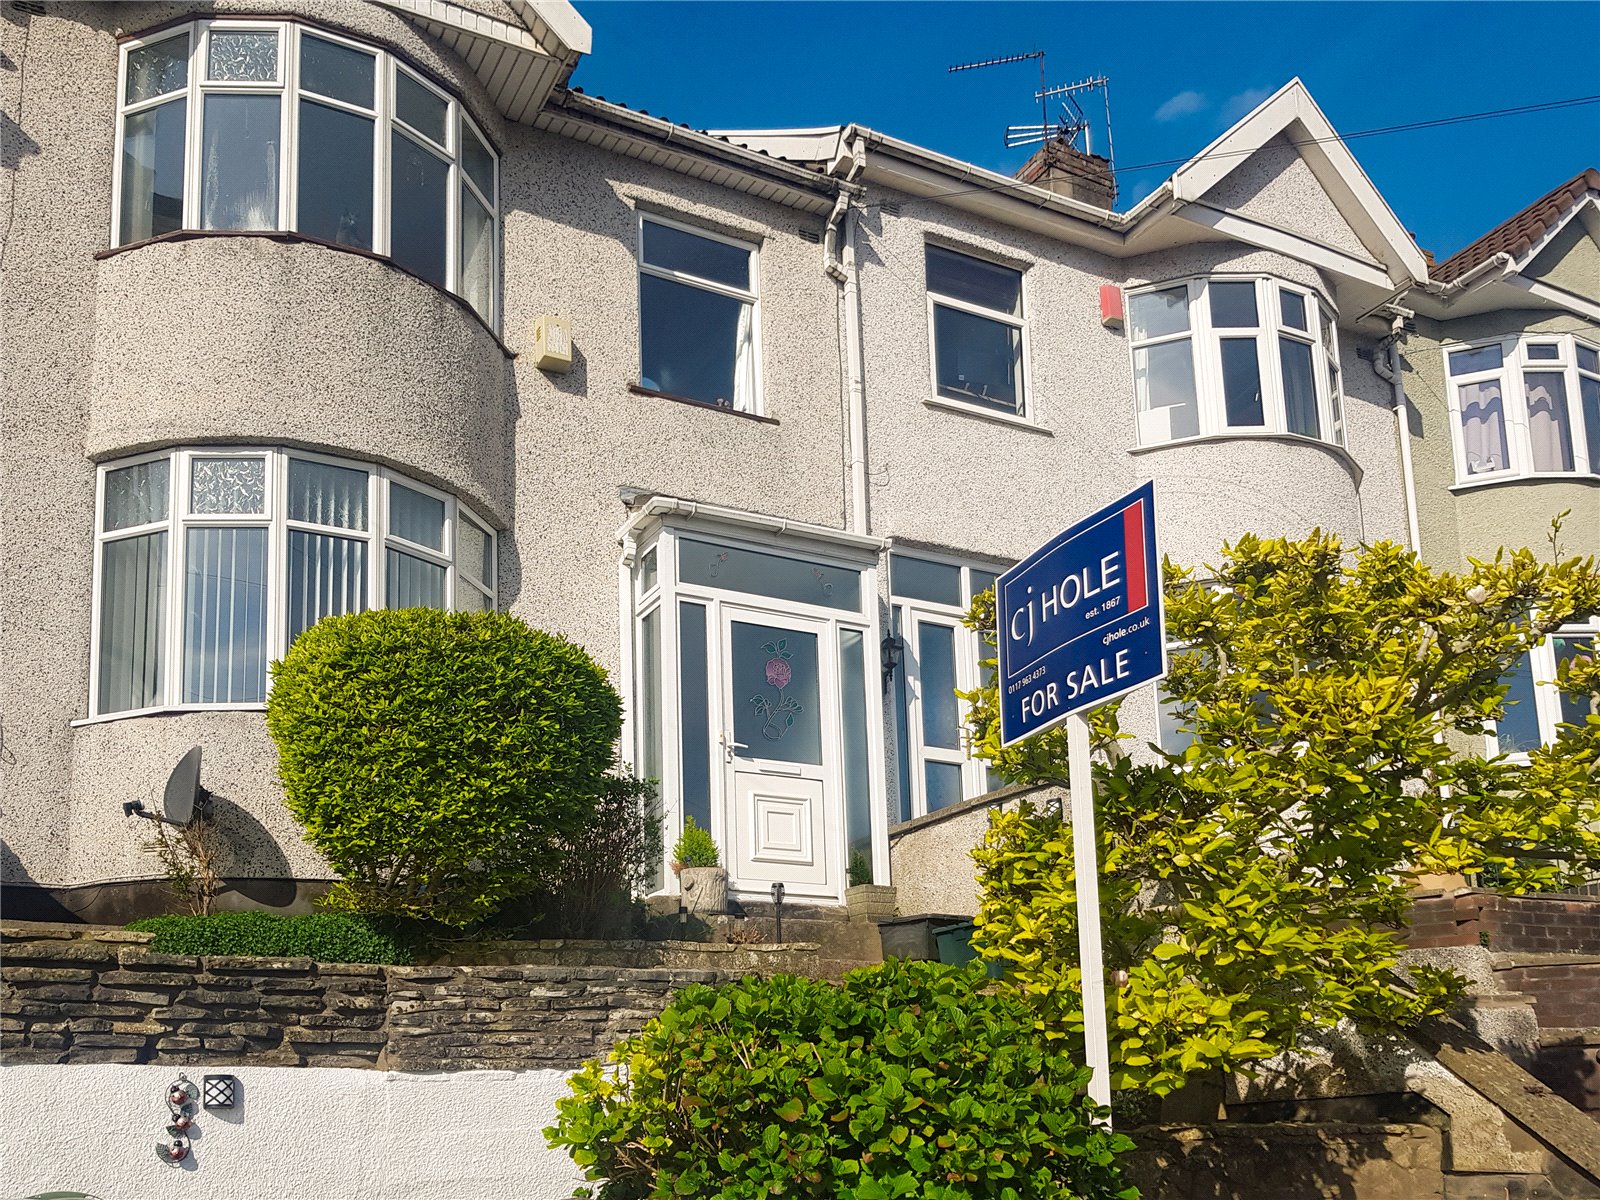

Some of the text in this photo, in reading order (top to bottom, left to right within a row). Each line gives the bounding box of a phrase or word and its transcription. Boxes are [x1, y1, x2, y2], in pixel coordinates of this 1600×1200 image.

[1041, 551, 1121, 623] HOLE
[1085, 595, 1121, 620] est. 1867
[1102, 616, 1150, 646] cjhole.co.uk
[1008, 665, 1046, 695] 0117 963 4373
[1021, 649, 1131, 724] FOR SALE
